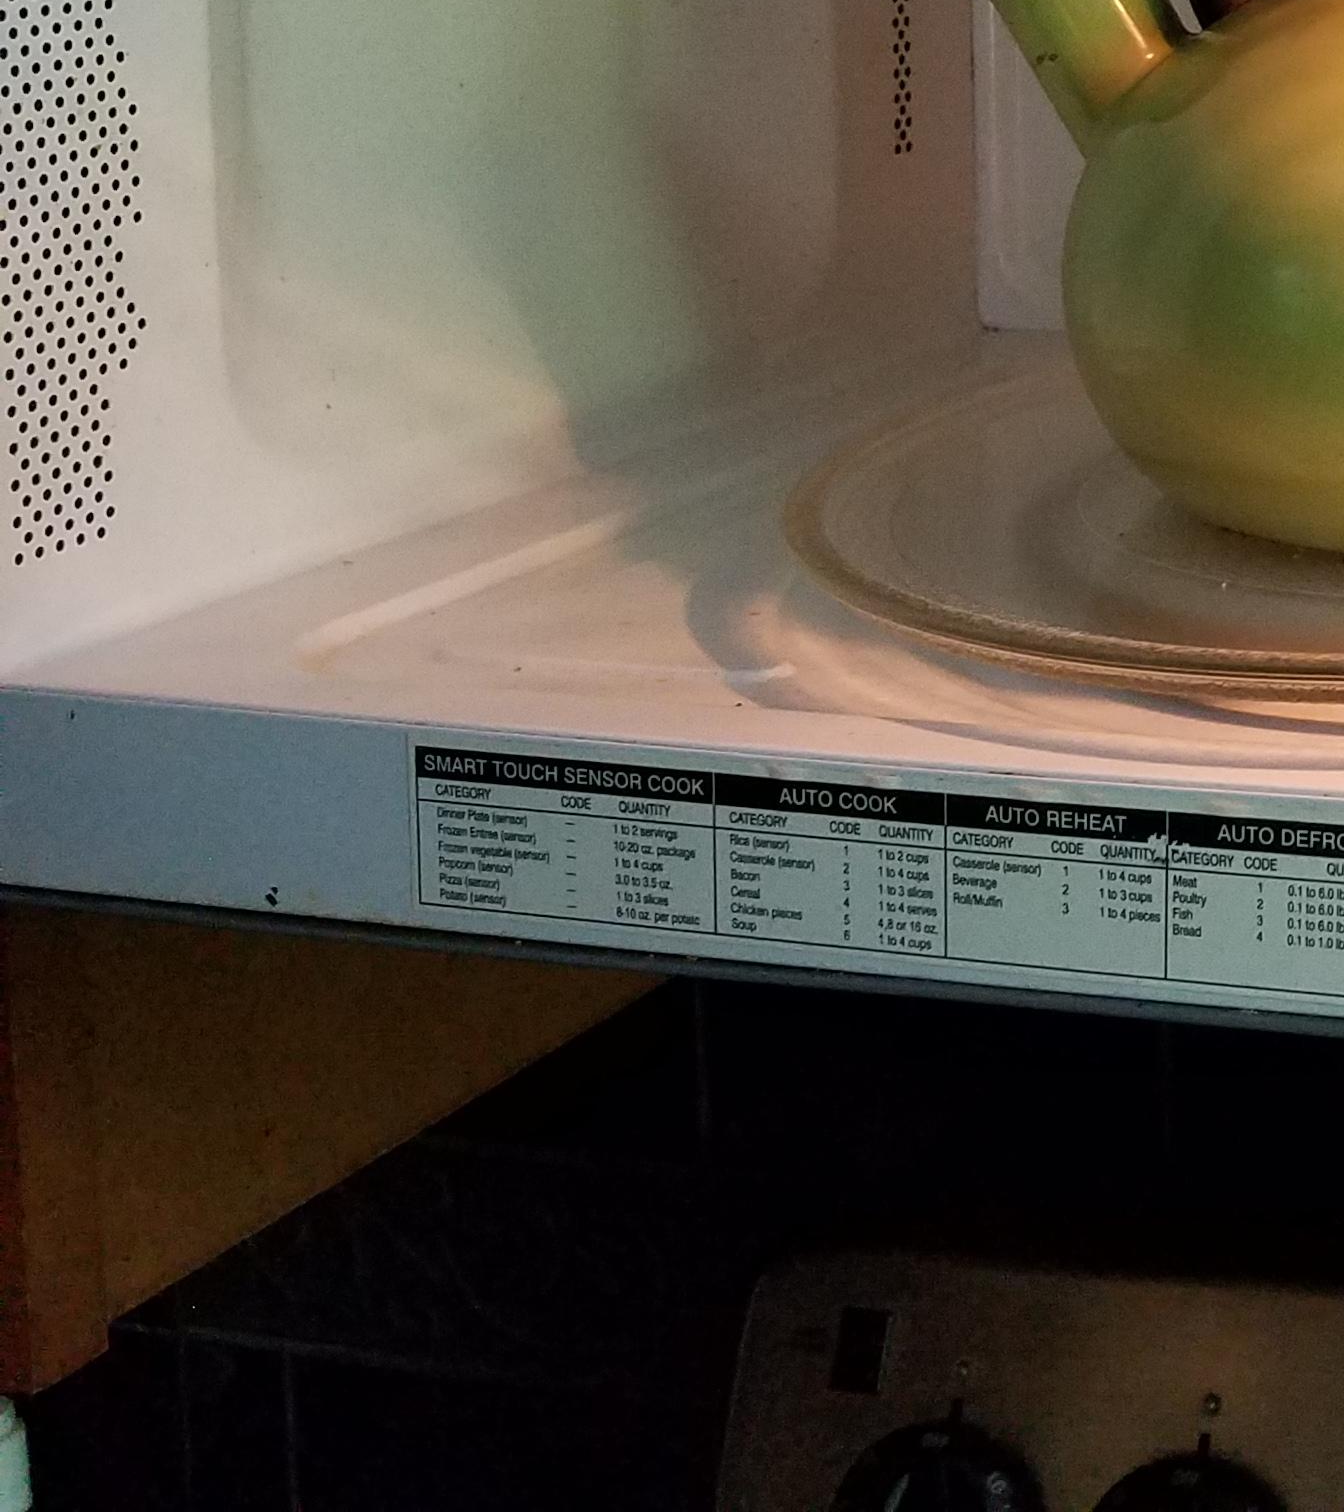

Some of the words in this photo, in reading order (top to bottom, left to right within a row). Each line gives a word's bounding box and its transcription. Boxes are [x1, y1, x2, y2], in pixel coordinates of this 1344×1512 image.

[424, 754, 487, 776] SMART
[492, 760, 558, 783] TOUCH
[564, 768, 642, 791] SENSOR
[647, 775, 704, 796] COOK
[435, 784, 491, 801] CATEGORY
[561, 796, 591, 810] CODE
[618, 801, 671, 817] QUANTITY
[779, 787, 833, 808] AUTO
[839, 792, 897, 814] COOK
[729, 811, 787, 828] CATEGORY
[829, 821, 861, 835] CODE
[879, 825, 933, 841] QUANTITY
[985, 805, 1039, 826] AUTO
[1047, 810, 1127, 833] REHEAT
[953, 832, 1013, 849] CATEGORY
[1051, 841, 1084, 855] CODE
[1100, 844, 1157, 862] QUANTITY
[1217, 824, 1274, 845] AUTO
[657, 846, 696, 860] package
[906, 853, 929, 865] cups
[1171, 850, 1234, 868] CATEGORY
[1244, 857, 1277, 871] CODE
[730, 868, 760, 882] Bacon
[907, 871, 929, 883] cups
[953, 857, 1000, 872] Casserole
[1003, 861, 1041, 878] (sensor)
[1128, 872, 1152, 885] cups
[953, 874, 997, 891] Beverage
[1128, 891, 1152, 903] cups
[1173, 874, 1197, 889] Meat
[1288, 885, 1302, 898] 0.1
[1306, 887, 1316, 899] to
[1318, 887, 1334, 901] 6.0
[1173, 891, 1206, 908] Poultry
[1288, 901, 1302, 914] 0.1
[1306, 903, 1316, 915] to
[1318, 904, 1334, 917] 6.0
[1172, 907, 1193, 921] Fish
[1287, 918, 1302, 930] 0.1
[1305, 919, 1315, 932] to
[1318, 920, 1333, 933] 6.0
[731, 918, 757, 932] Soup
[908, 939, 931, 952] cups
[1172, 923, 1201, 938] Bread
[1287, 934, 1302, 947] 0.1
[1305, 936, 1315, 948] to
[1319, 937, 1333, 950] 1.0
